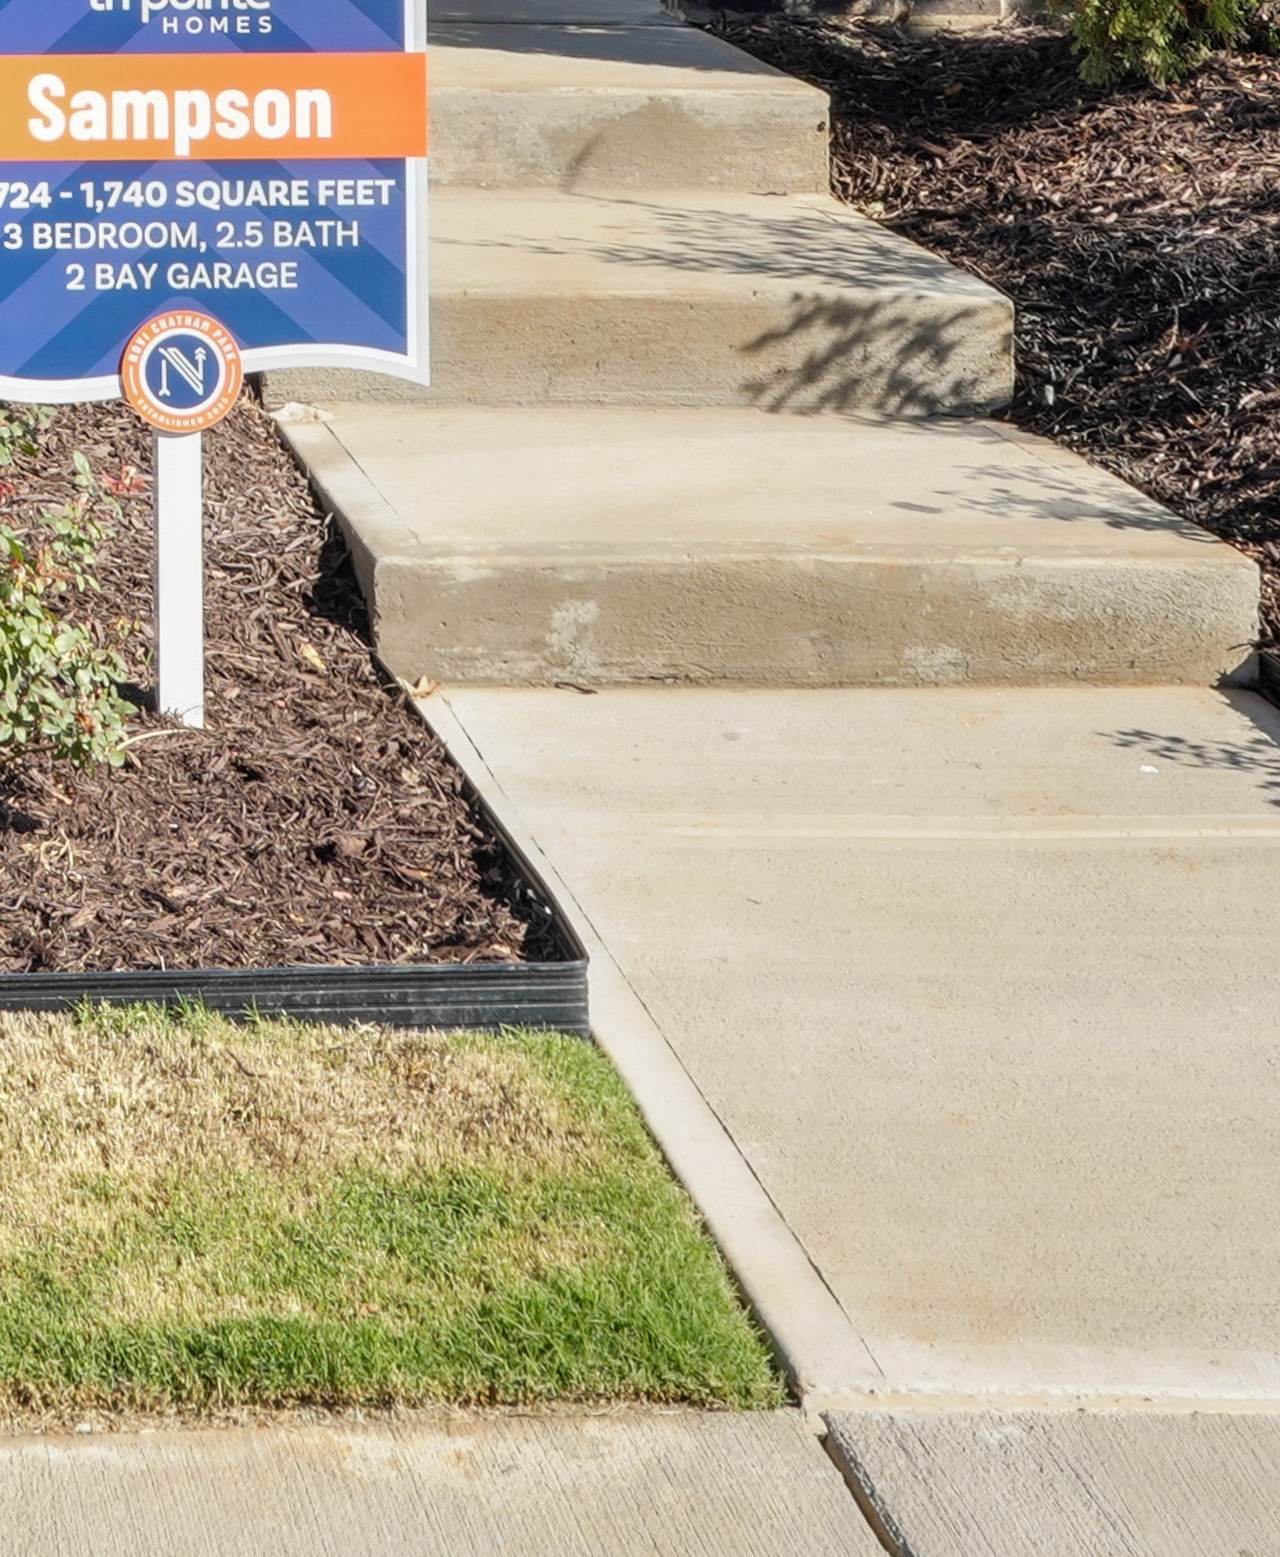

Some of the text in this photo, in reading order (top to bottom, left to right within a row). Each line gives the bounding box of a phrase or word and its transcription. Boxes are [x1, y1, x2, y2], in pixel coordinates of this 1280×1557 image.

[162, 15, 273, 35] HOMES
[27, 72, 333, 157] Sampson
[59, 191, 73, 199] -
[79, 180, 168, 214] 1,740
[175, 179, 310, 211] SQUARE
[317, 178, 396, 206] FEET
[3, 220, 359, 254] 3 BEDROOM, 2.5 BATH
[65, 261, 299, 291] 2 BAY GARAGE
[127, 314, 237, 363] NOVI CHATHAM PARK
